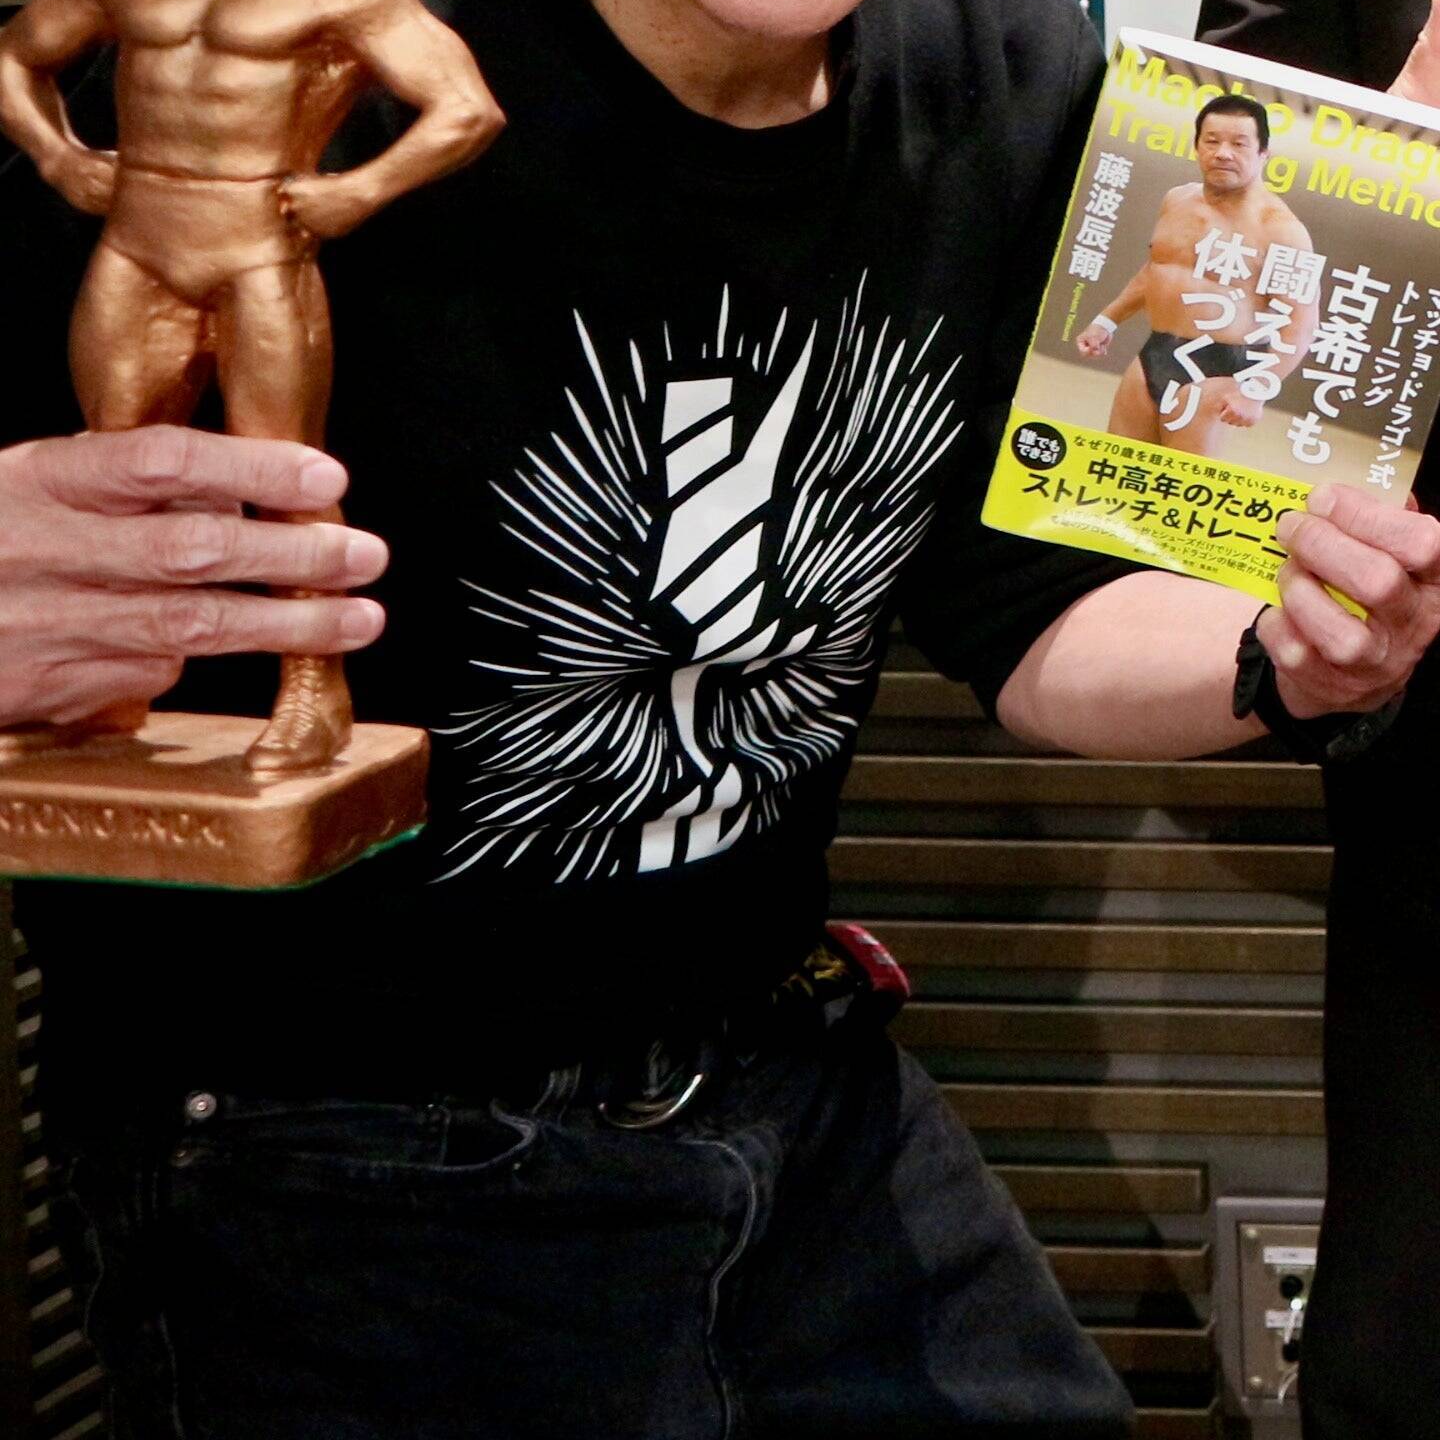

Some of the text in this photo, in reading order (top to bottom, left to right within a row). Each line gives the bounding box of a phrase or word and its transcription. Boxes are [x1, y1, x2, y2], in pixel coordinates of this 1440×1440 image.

[1107, 97, 1300, 194] Traig
[1114, 48, 1297, 134] Maco
[1068, 151, 1134, 282] 藤波辰爾
[1159, 227, 1258, 432] 体づくり
[1233, 243, 1328, 402] 闘える
[1286, 264, 1392, 465] 古希でも
[1362, 280, 1421, 408] トレーニング
[1018, 428, 1061, 453] 誰でも
[1073, 435, 1309, 502] なぜ70歳を超えても現役でいられるの
[1022, 472, 1290, 560] ストレッチ&トレーニ
